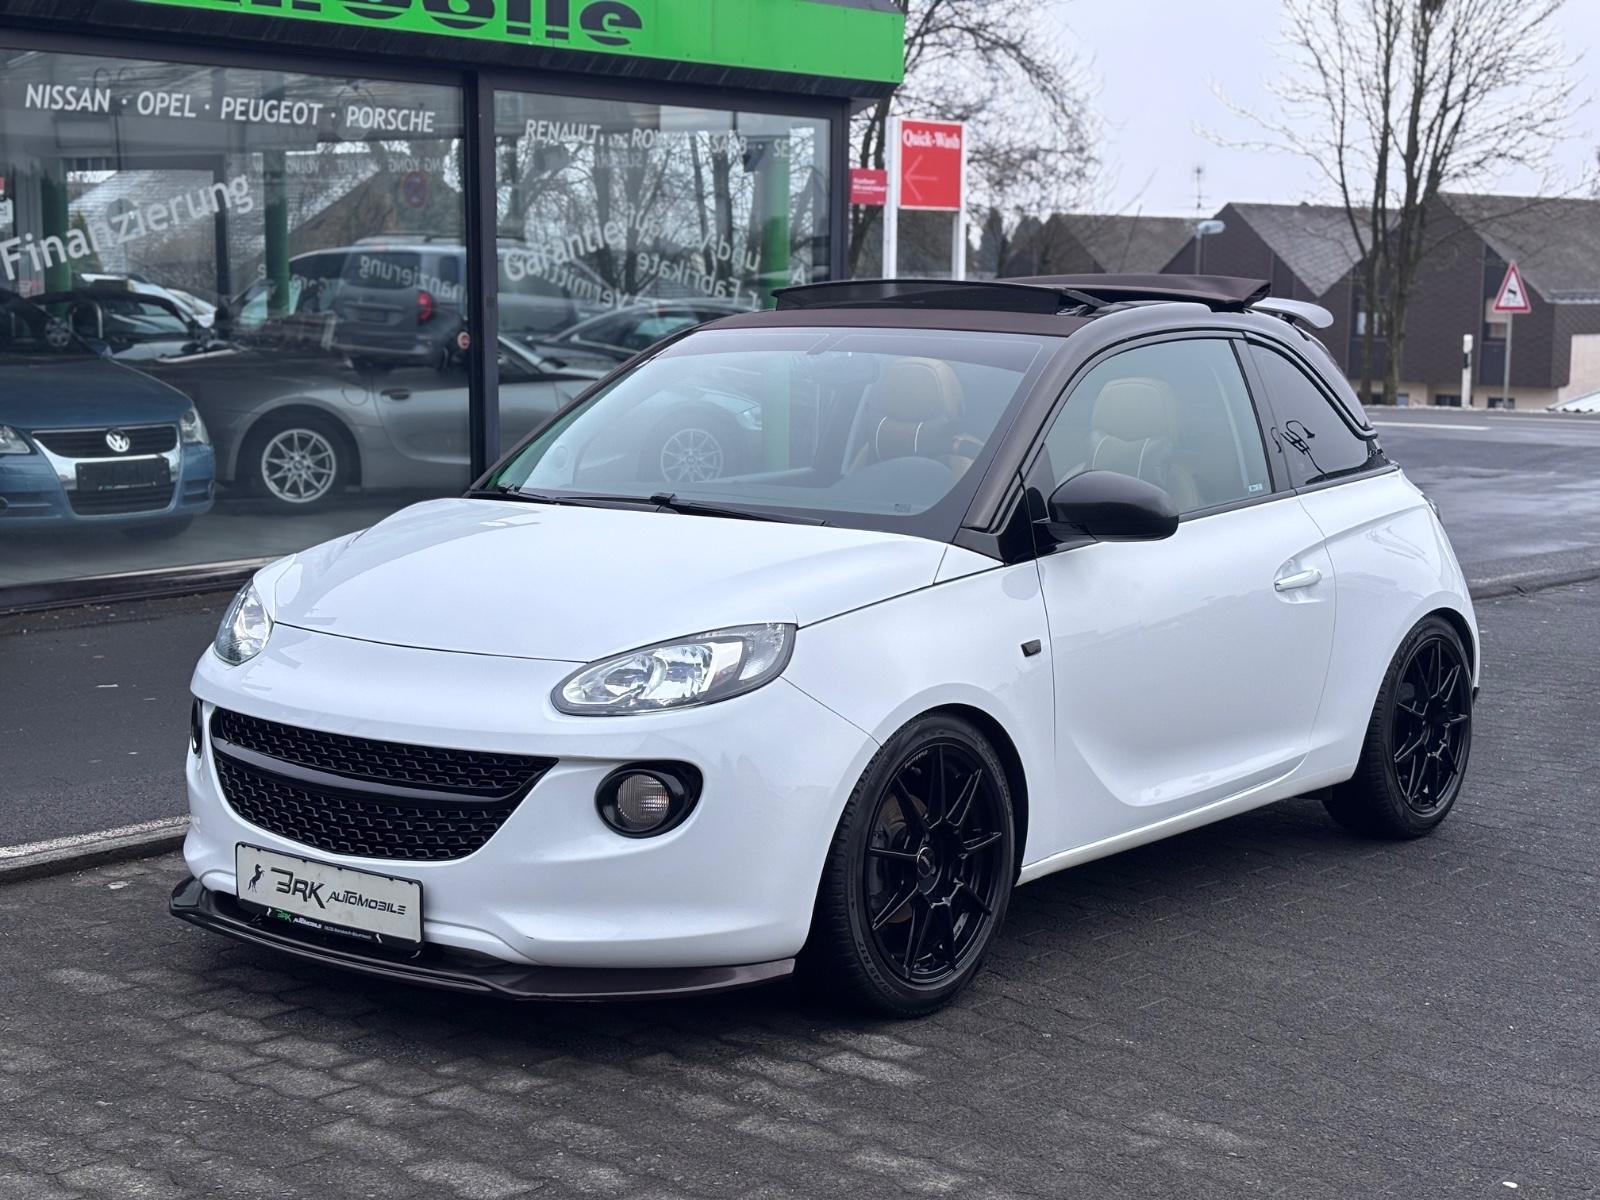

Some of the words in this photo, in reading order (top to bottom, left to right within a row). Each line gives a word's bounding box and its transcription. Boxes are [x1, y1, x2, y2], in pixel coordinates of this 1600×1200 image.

[25, 83, 110, 113] NISSAN
[137, 91, 196, 118] OPEL
[221, 97, 323, 125] PEUGEOT
[346, 105, 435, 132] PORSCHE
[524, 119, 602, 144] RENAULT
[0, 174, 254, 281] Finanzierung
[503, 220, 619, 282] Garantie
